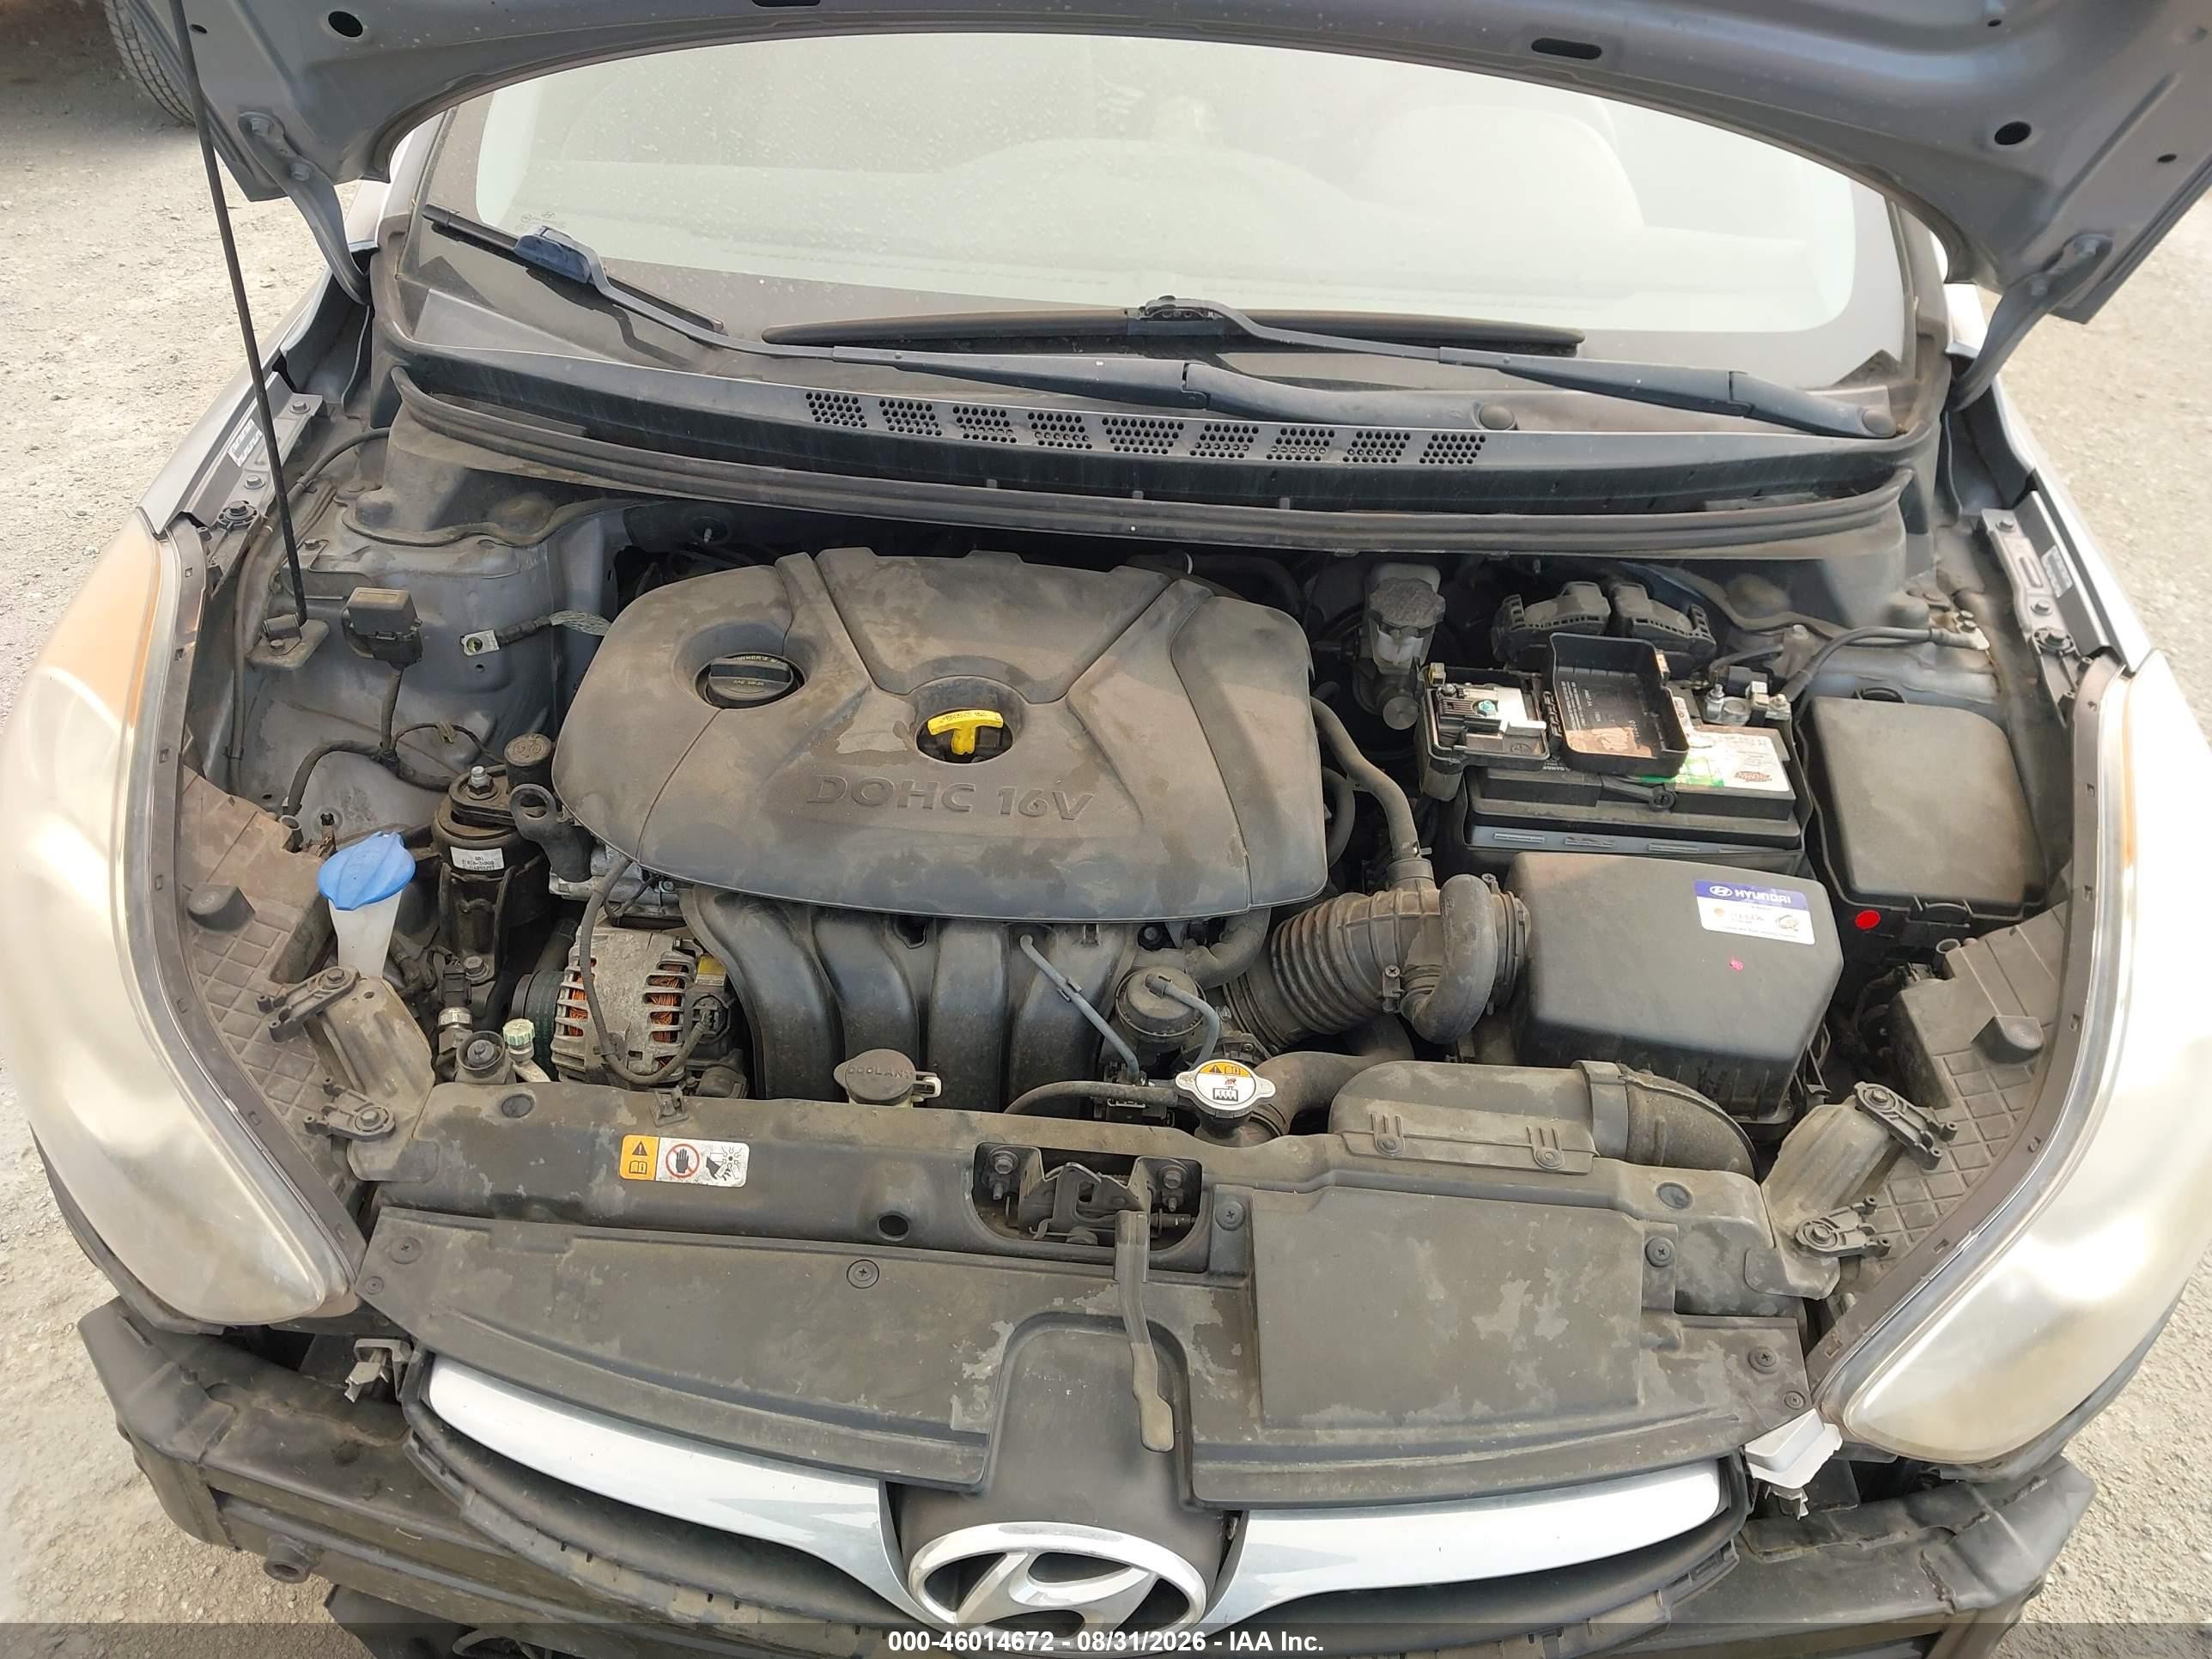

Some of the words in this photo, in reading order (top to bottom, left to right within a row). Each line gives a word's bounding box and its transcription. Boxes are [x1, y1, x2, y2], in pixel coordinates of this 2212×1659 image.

[806, 775, 975, 812] DOHC
[998, 787, 1095, 820] 16V
[1735, 888, 1791, 904] HYUNDAI
[848, 1065, 914, 1079] COOLANT
